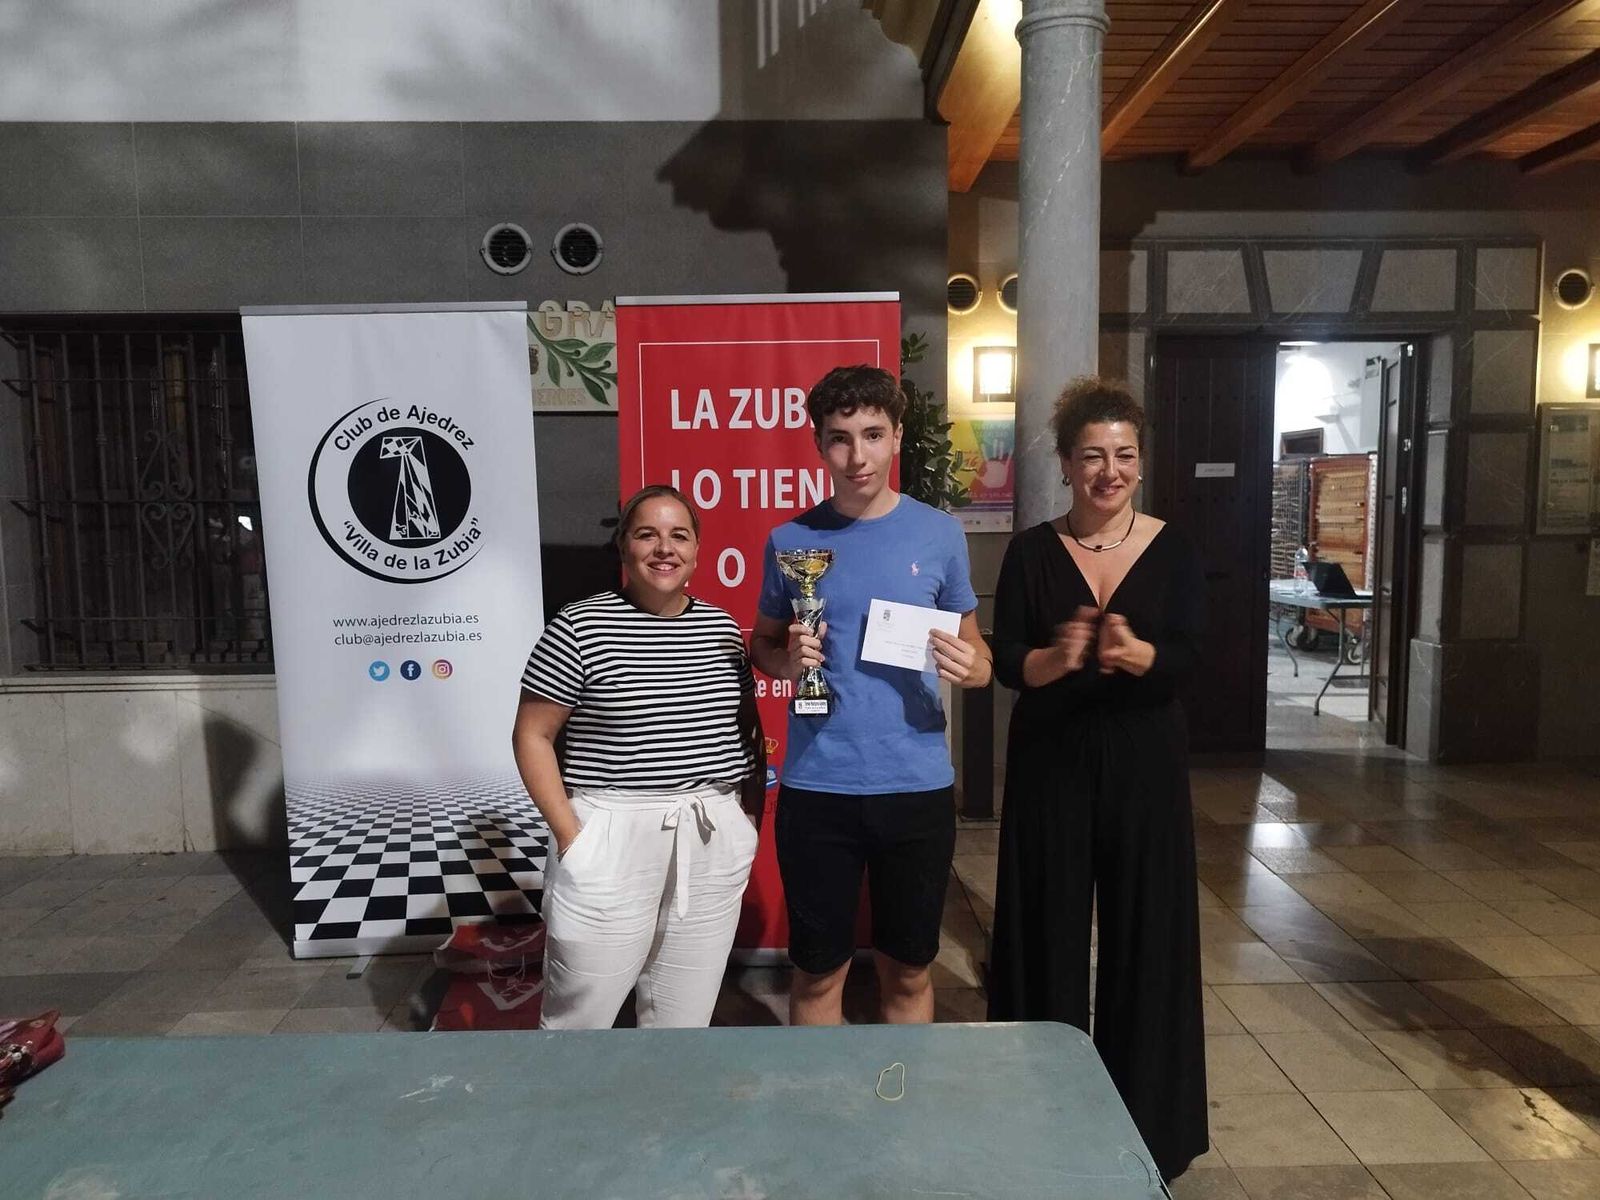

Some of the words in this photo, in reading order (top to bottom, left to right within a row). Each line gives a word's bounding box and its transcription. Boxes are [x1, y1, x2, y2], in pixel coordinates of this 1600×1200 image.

[671, 388, 719, 430] LA
[728, 387, 816, 430] ZUB
[334, 416, 373, 451] Club
[377, 406, 401, 423] de
[406, 404, 475, 451] Ajedrez
[732, 468, 835, 510] TIEN
[384, 553, 408, 570] de
[414, 555, 431, 571] la
[333, 612, 479, 630] www.ajedrezlazubia.es
[334, 630, 482, 647] club@ajedrezlazubia.es
[772, 678, 792, 698] en
